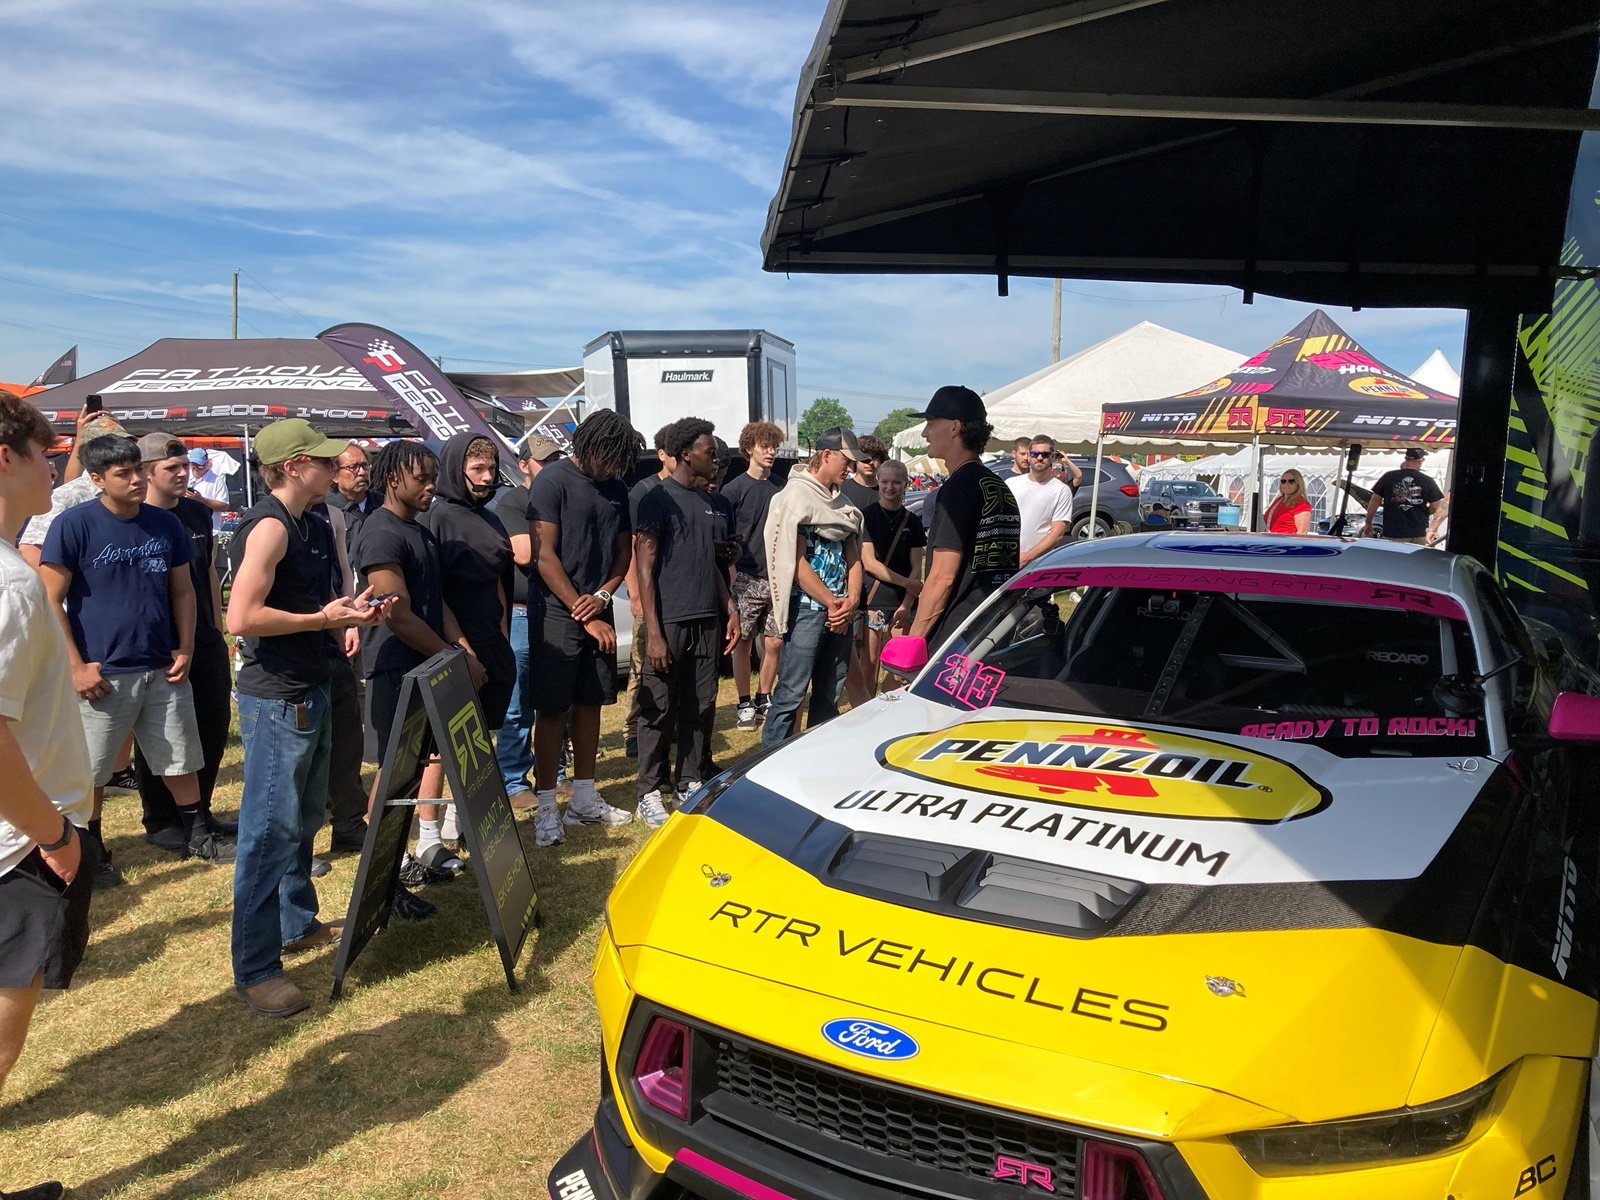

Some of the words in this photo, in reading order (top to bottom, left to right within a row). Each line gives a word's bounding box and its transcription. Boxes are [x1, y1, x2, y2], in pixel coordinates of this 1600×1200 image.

[122, 365, 363, 380] FATHOUS
[1141, 412, 1197, 422] NITTO
[1352, 414, 1456, 428] NITTO
[1104, 572, 1260, 588] MUSTANG
[1270, 579, 1342, 593] RTR
[1366, 650, 1429, 666] RECARO
[934, 653, 1006, 710] 213
[1240, 718, 1335, 740] READY
[1341, 717, 1379, 736] TO
[1387, 716, 1476, 738] ROCK!
[478, 801, 499, 841] WANT
[498, 795, 505, 814] A
[833, 789, 968, 821] ULTRA
[971, 803, 1232, 878] PLATINUM
[1551, 856, 1577, 981] NITTO
[709, 900, 821, 948] RTR
[838, 928, 1171, 1032] VEHICLES
[838, 1022, 902, 1057] Ford
[1513, 1154, 1557, 1200] BC
